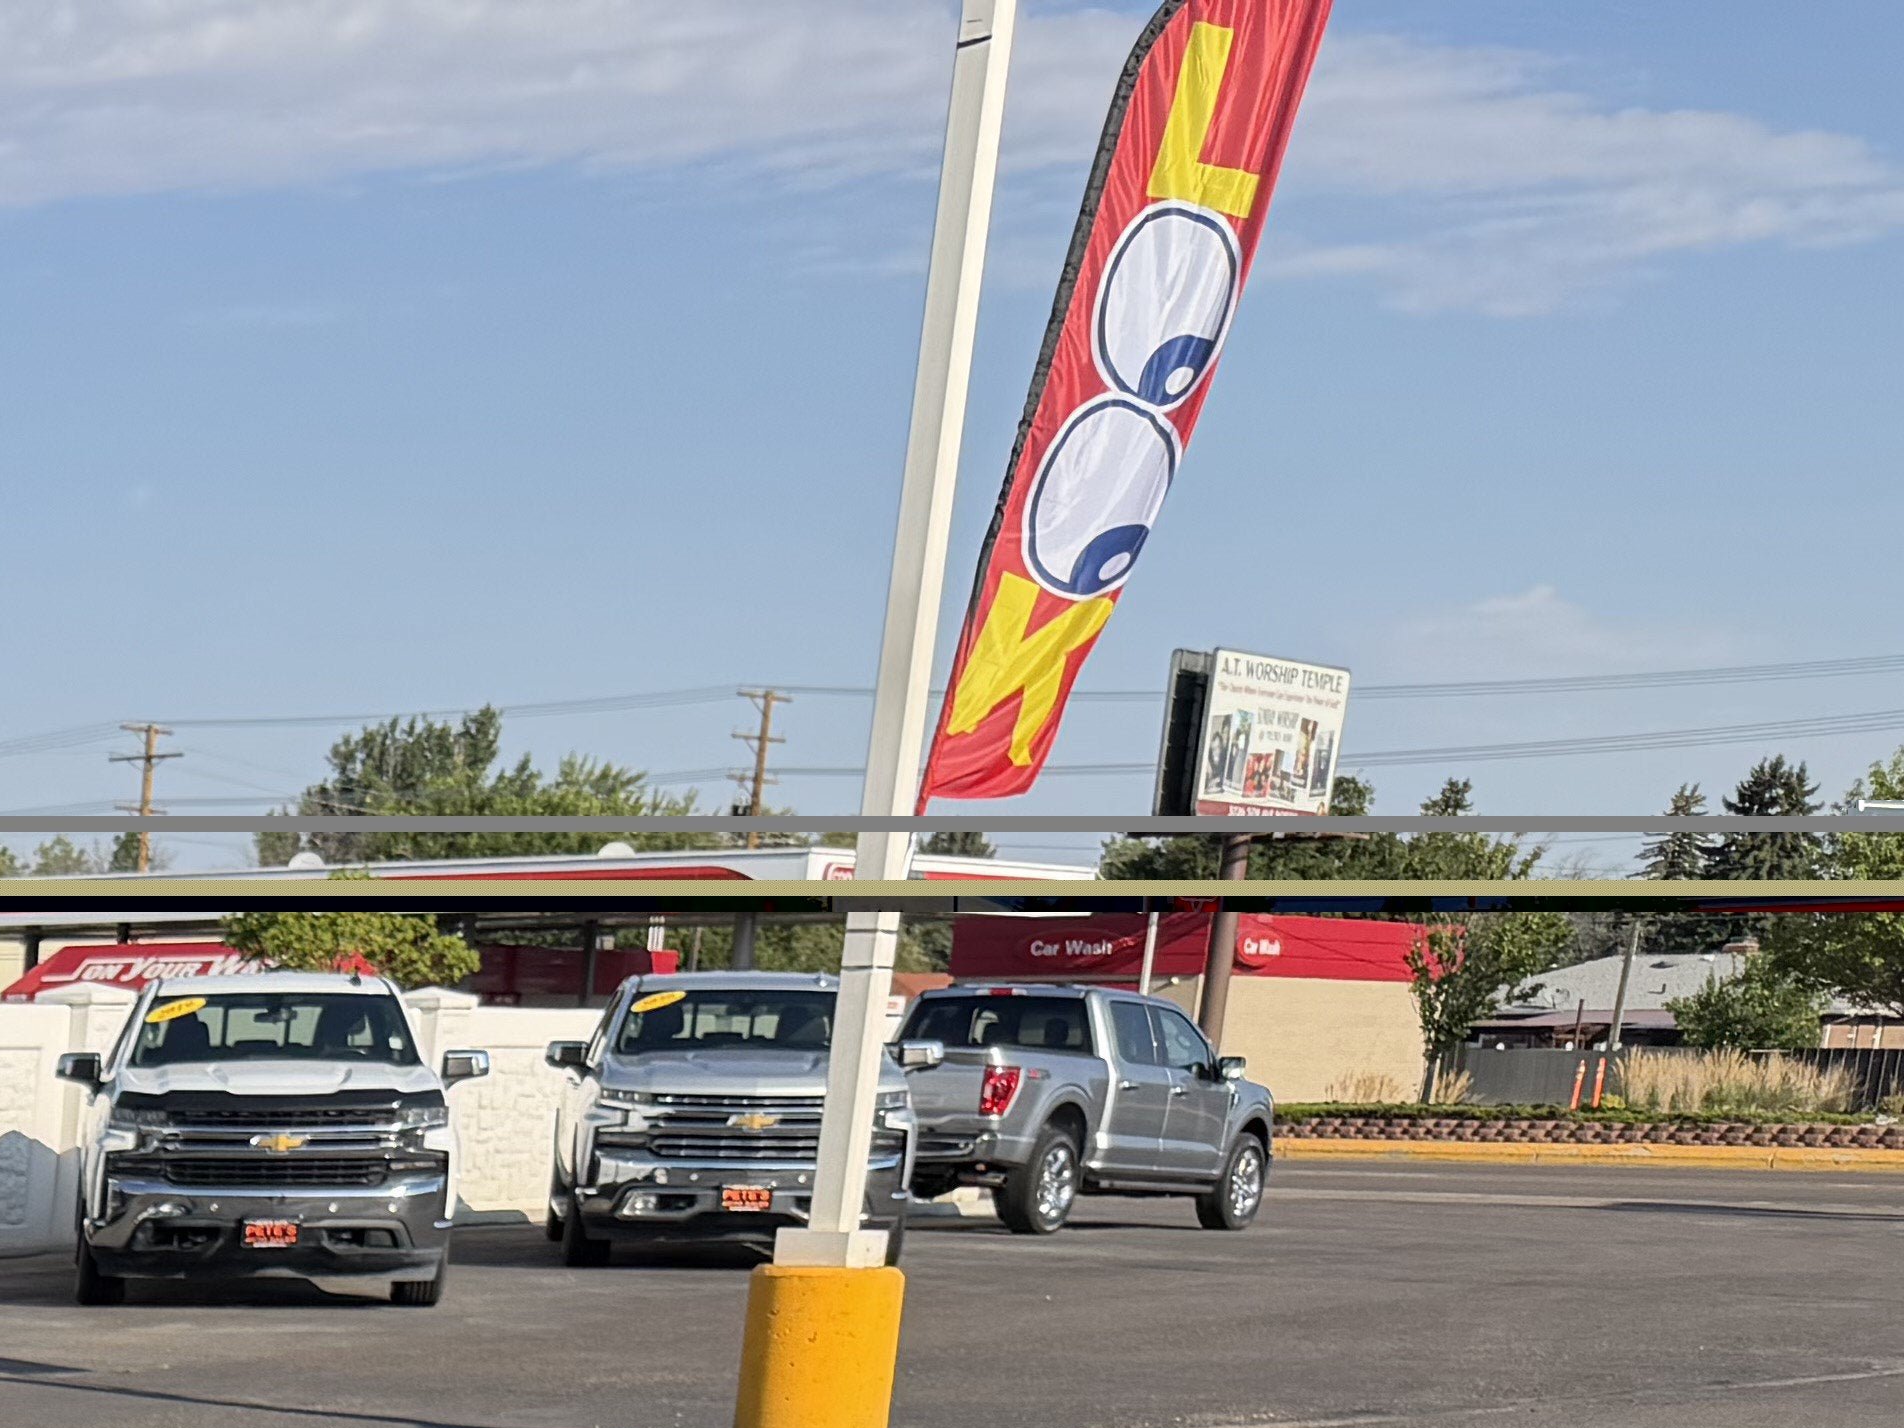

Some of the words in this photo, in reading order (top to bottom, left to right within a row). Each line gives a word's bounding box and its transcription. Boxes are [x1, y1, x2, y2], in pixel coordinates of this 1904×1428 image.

[1246, 660, 1299, 684] WORSHIP
[1302, 669, 1344, 693] TEMPLE
[1029, 939, 1060, 956] Car
[1065, 938, 1113, 955] Wash
[120, 956, 202, 982] YOUR
